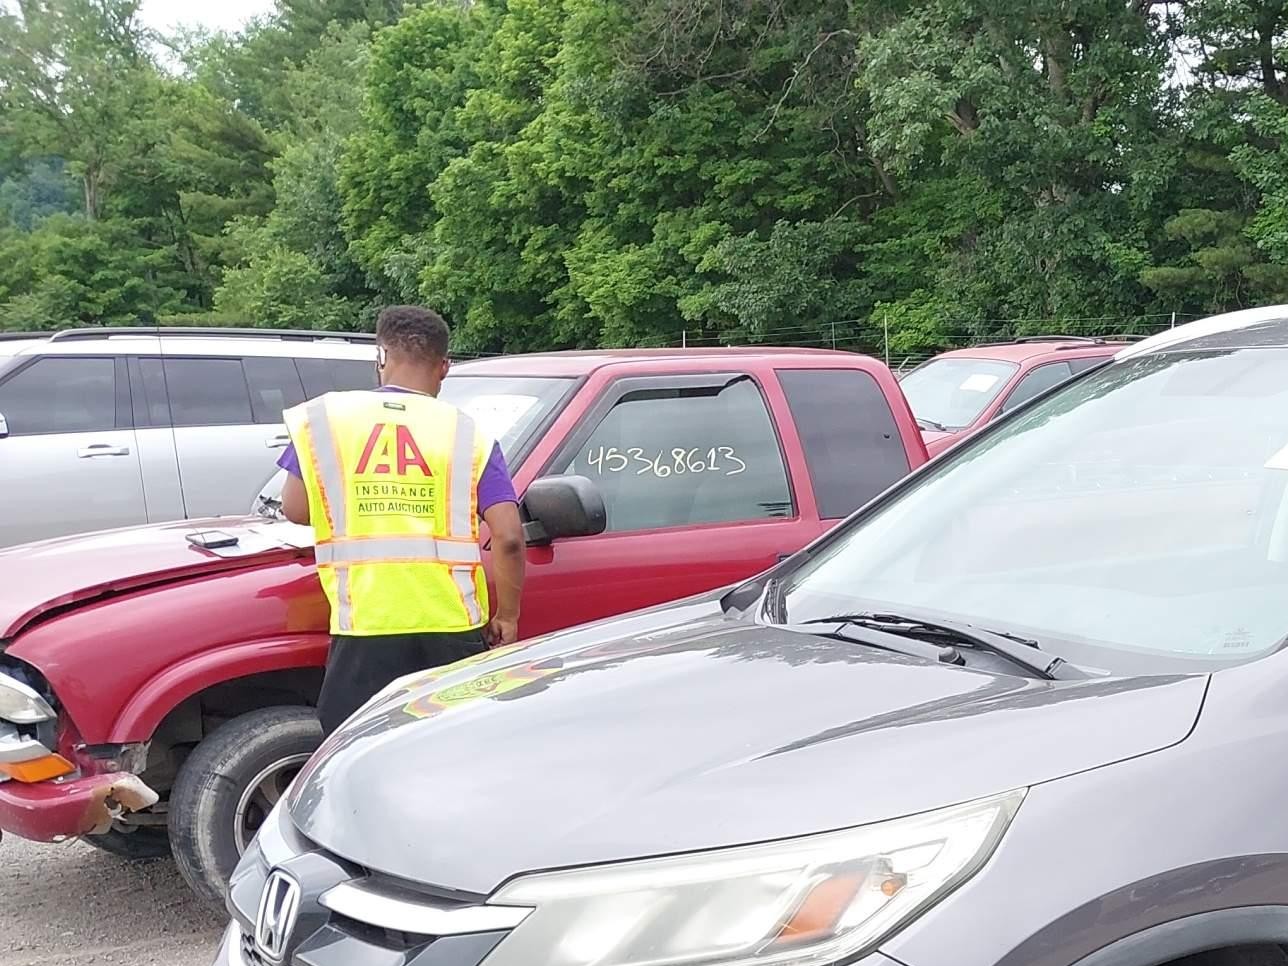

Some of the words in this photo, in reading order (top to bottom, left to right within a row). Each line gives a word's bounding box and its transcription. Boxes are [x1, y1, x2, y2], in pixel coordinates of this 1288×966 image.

[587, 445, 746, 478] 45368613
[355, 485, 435, 498] INSURANCE
[358, 502, 385, 513] AUTO
[387, 502, 435, 514] AUCTIONS
